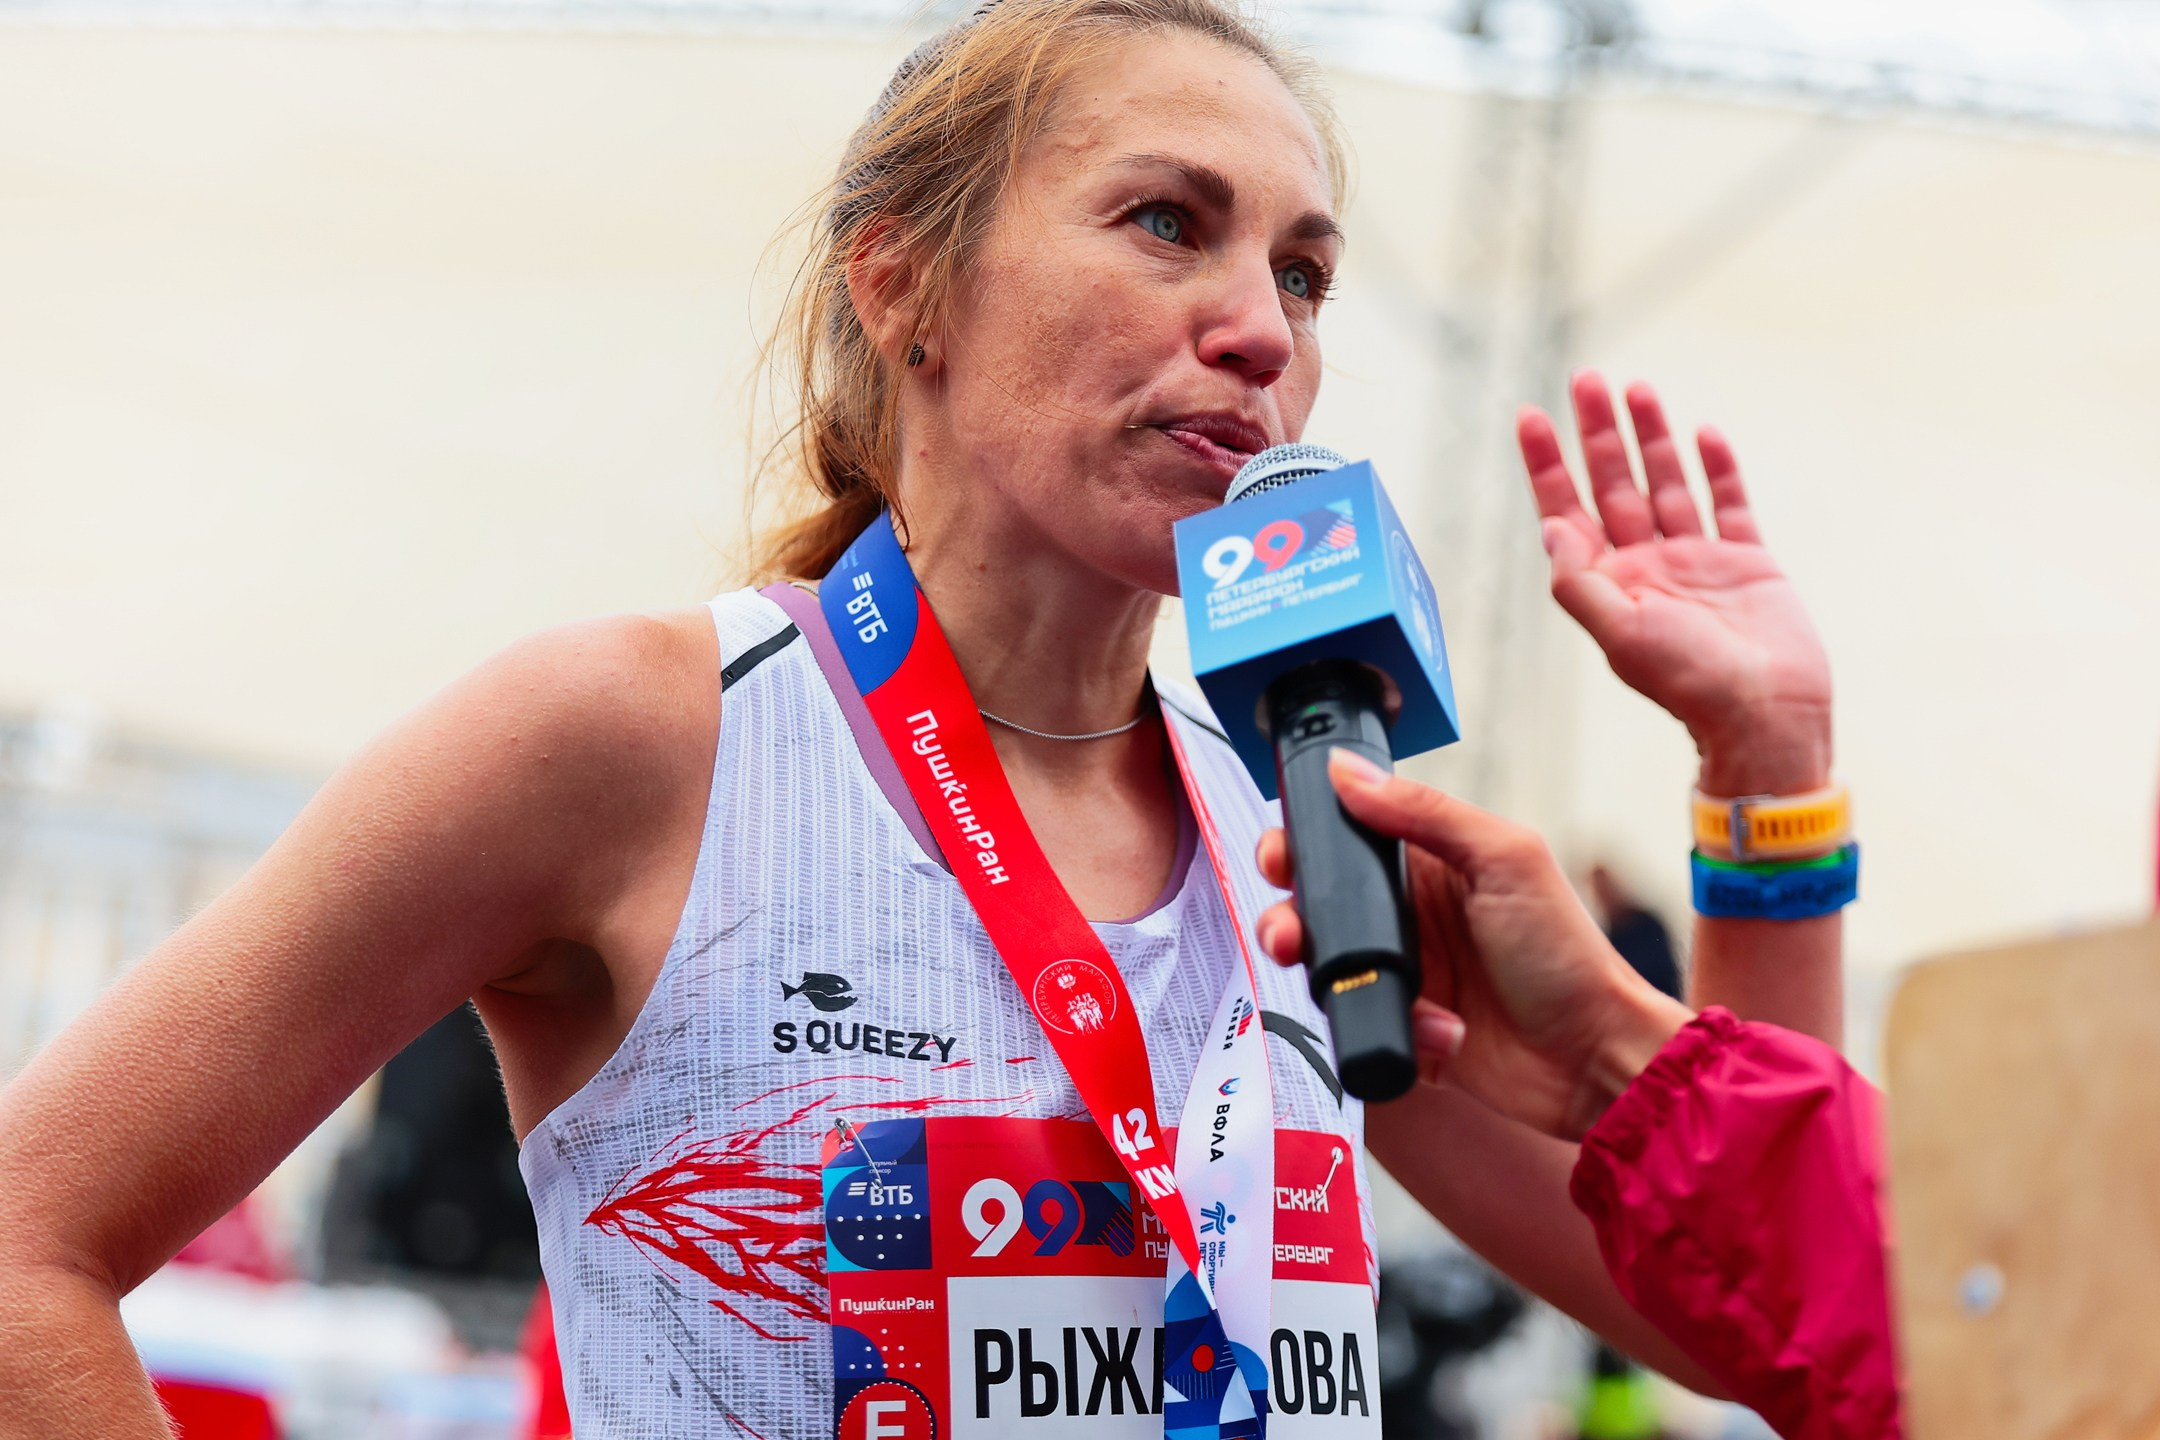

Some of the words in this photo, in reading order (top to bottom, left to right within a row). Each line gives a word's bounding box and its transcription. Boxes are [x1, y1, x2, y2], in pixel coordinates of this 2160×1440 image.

[1202, 520, 1304, 590] 99
[845, 590, 889, 644] ВТБ
[773, 1019, 957, 1063] SQUEEZY
[1112, 1107, 1155, 1161] 42
[1209, 1103, 1231, 1163] ВФЛА
[870, 1184, 914, 1206] ВТБ
[961, 1178, 1084, 1257] 99
[1274, 1184, 1330, 1214] СКИЙ
[1218, 1241, 1226, 1258] МЫ
[1273, 1244, 1333, 1265] ЕРБУРГ
